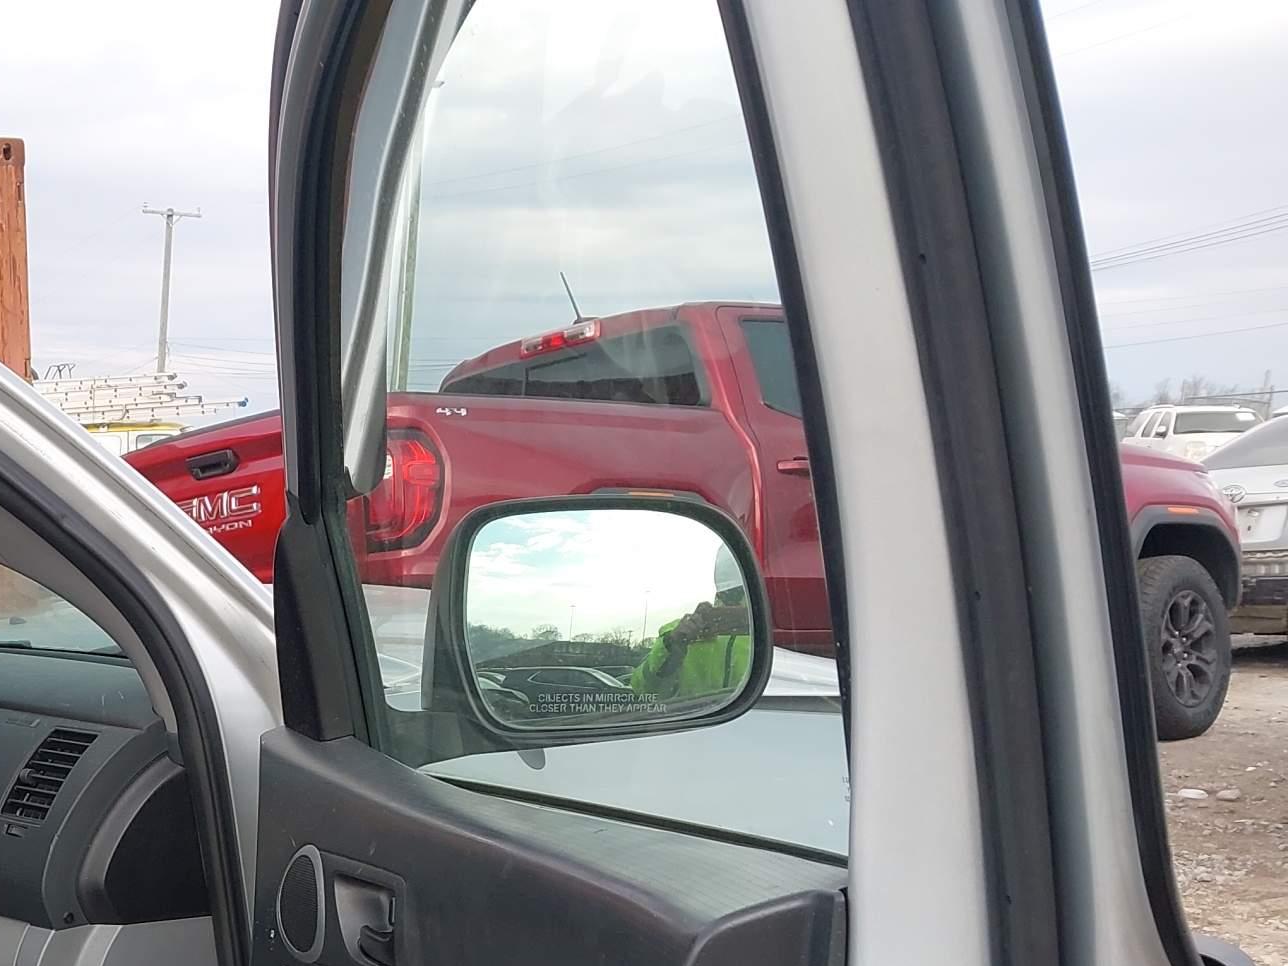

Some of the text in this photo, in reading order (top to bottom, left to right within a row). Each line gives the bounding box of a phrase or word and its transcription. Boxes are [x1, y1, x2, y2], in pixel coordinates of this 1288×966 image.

[538, 693, 659, 703] OBJECTS IN MIRROR ARE
[529, 703, 667, 713] CLOSER THAN THEY APPEAR
